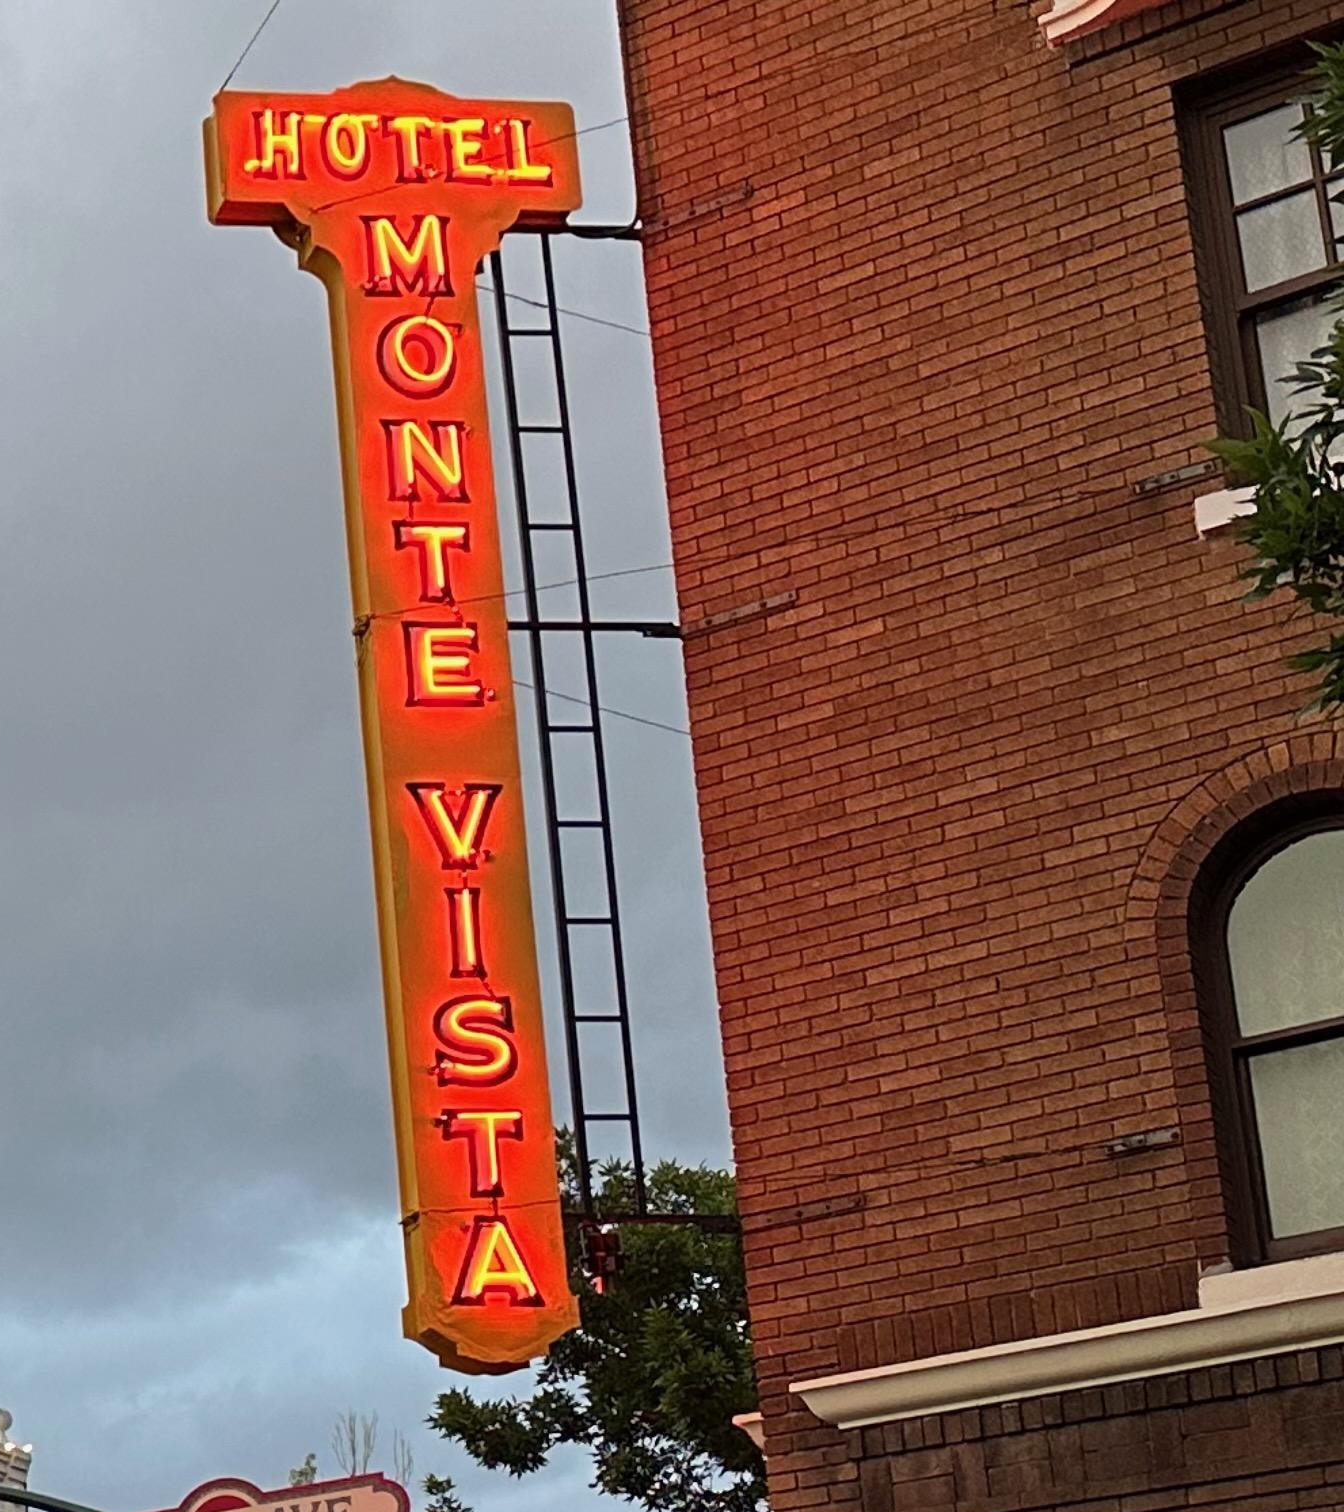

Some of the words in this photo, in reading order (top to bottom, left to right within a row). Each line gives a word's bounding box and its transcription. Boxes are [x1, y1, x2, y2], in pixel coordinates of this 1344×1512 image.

[244, 109, 554, 188] HOTEL
[362, 214, 486, 707] MONTE
[405, 782, 546, 1308] VISTA
